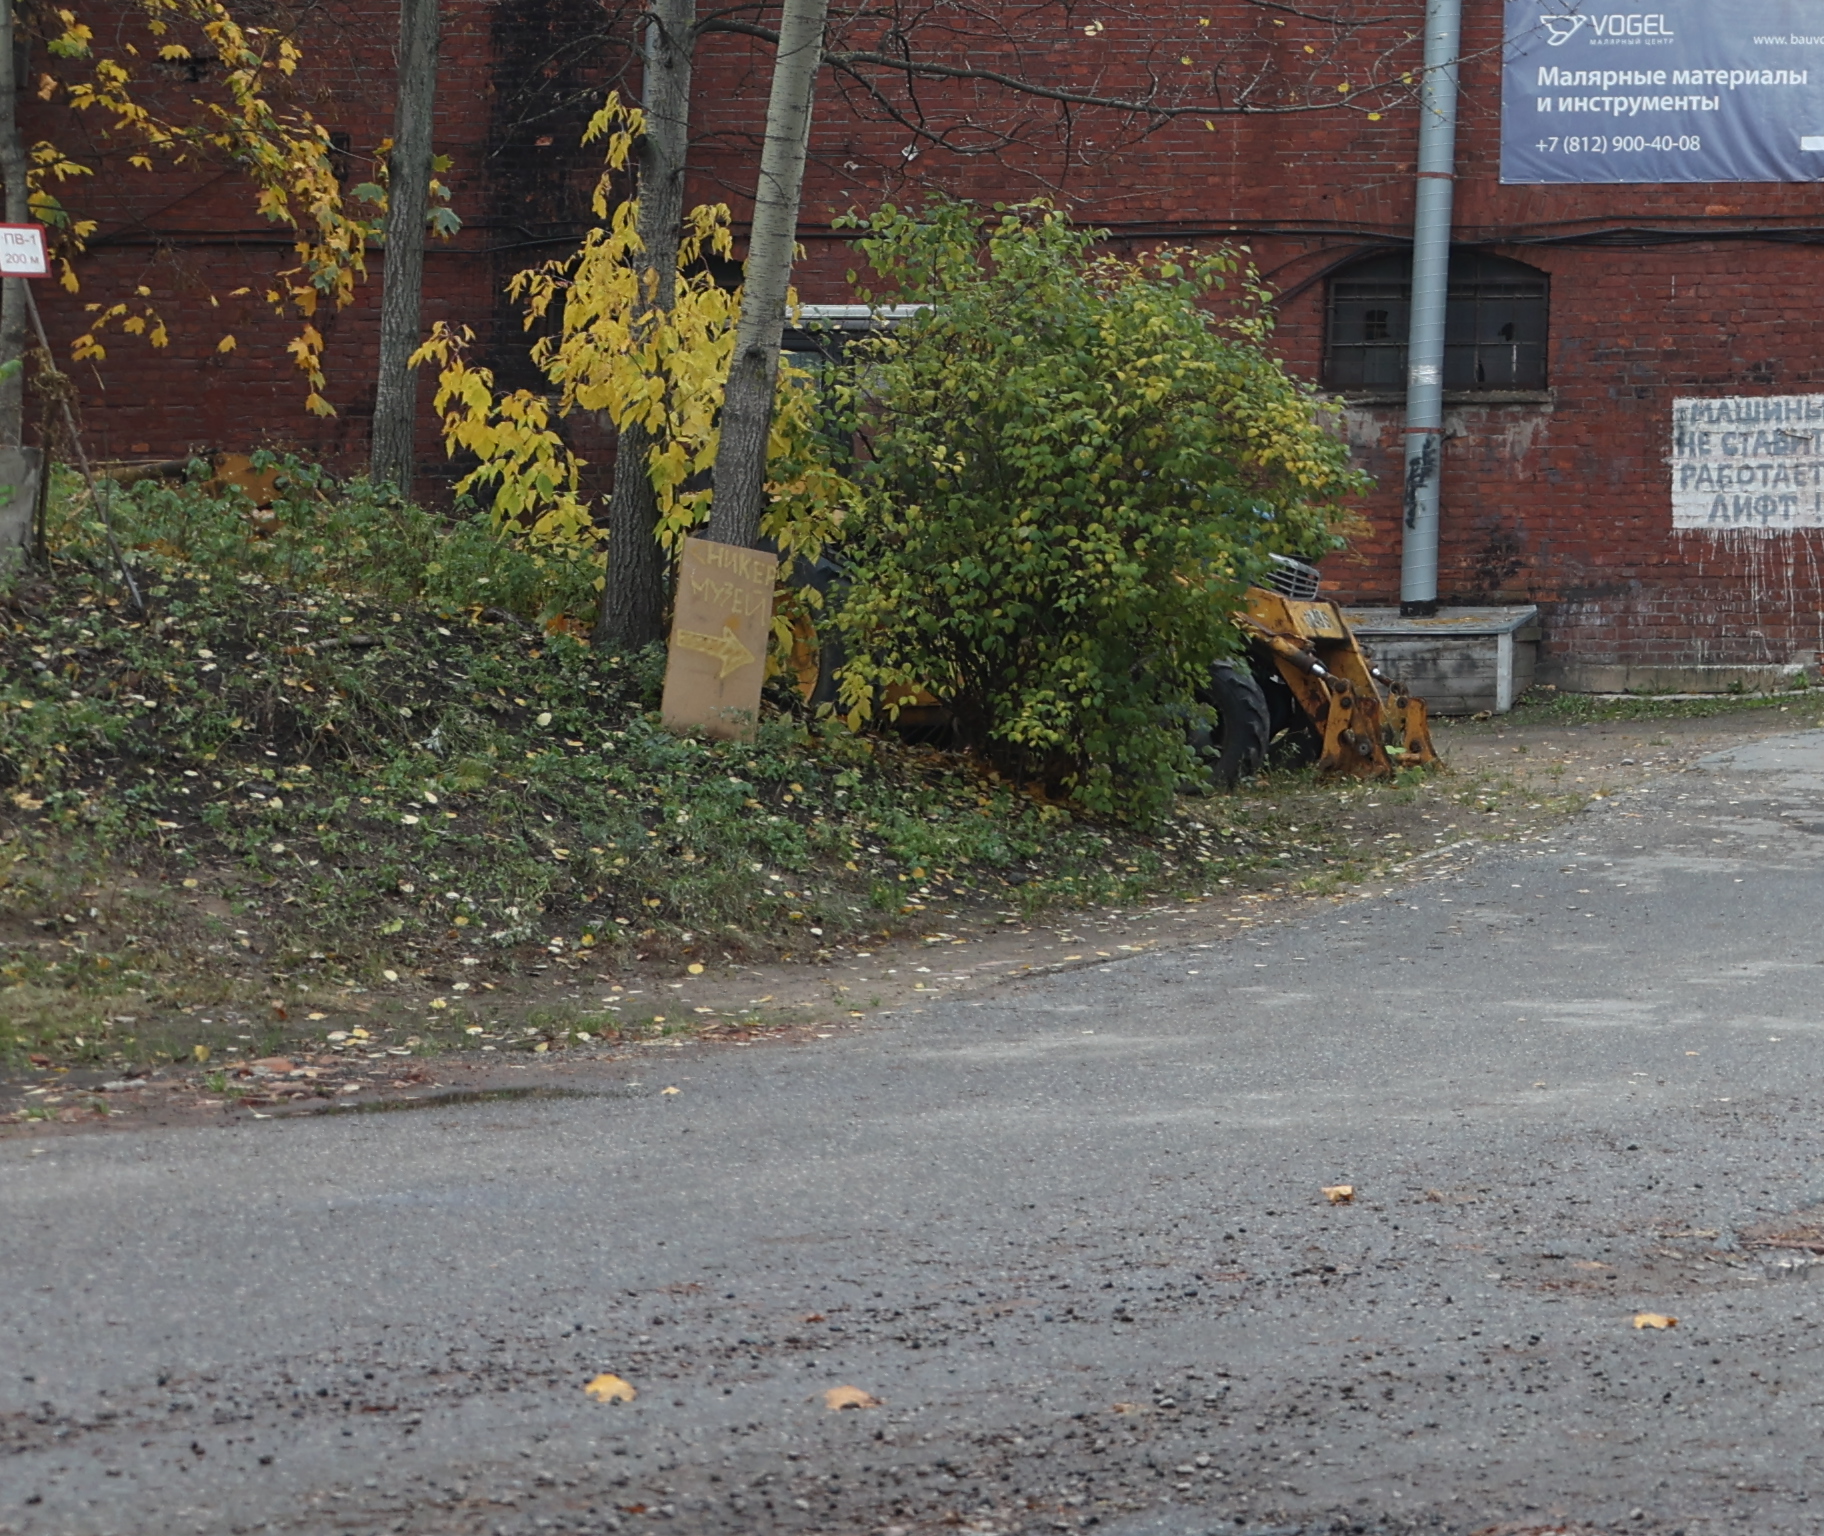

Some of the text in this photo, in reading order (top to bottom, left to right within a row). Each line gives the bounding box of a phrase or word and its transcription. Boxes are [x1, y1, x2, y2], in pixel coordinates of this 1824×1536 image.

[1590, 14, 1674, 36] VOGEL
[1644, 38, 1675, 46] ЦЕНТР
[1537, 66, 1807, 90] Малярные материалы
[1537, 94, 1719, 116] и инструменты
[1536, 135, 1701, 155] +7 (812) 900-40-08
[5, 253, 27, 264] 200
[1677, 431, 1711, 457] НЕ
[690, 574, 766, 627] МУЗЕЙ
